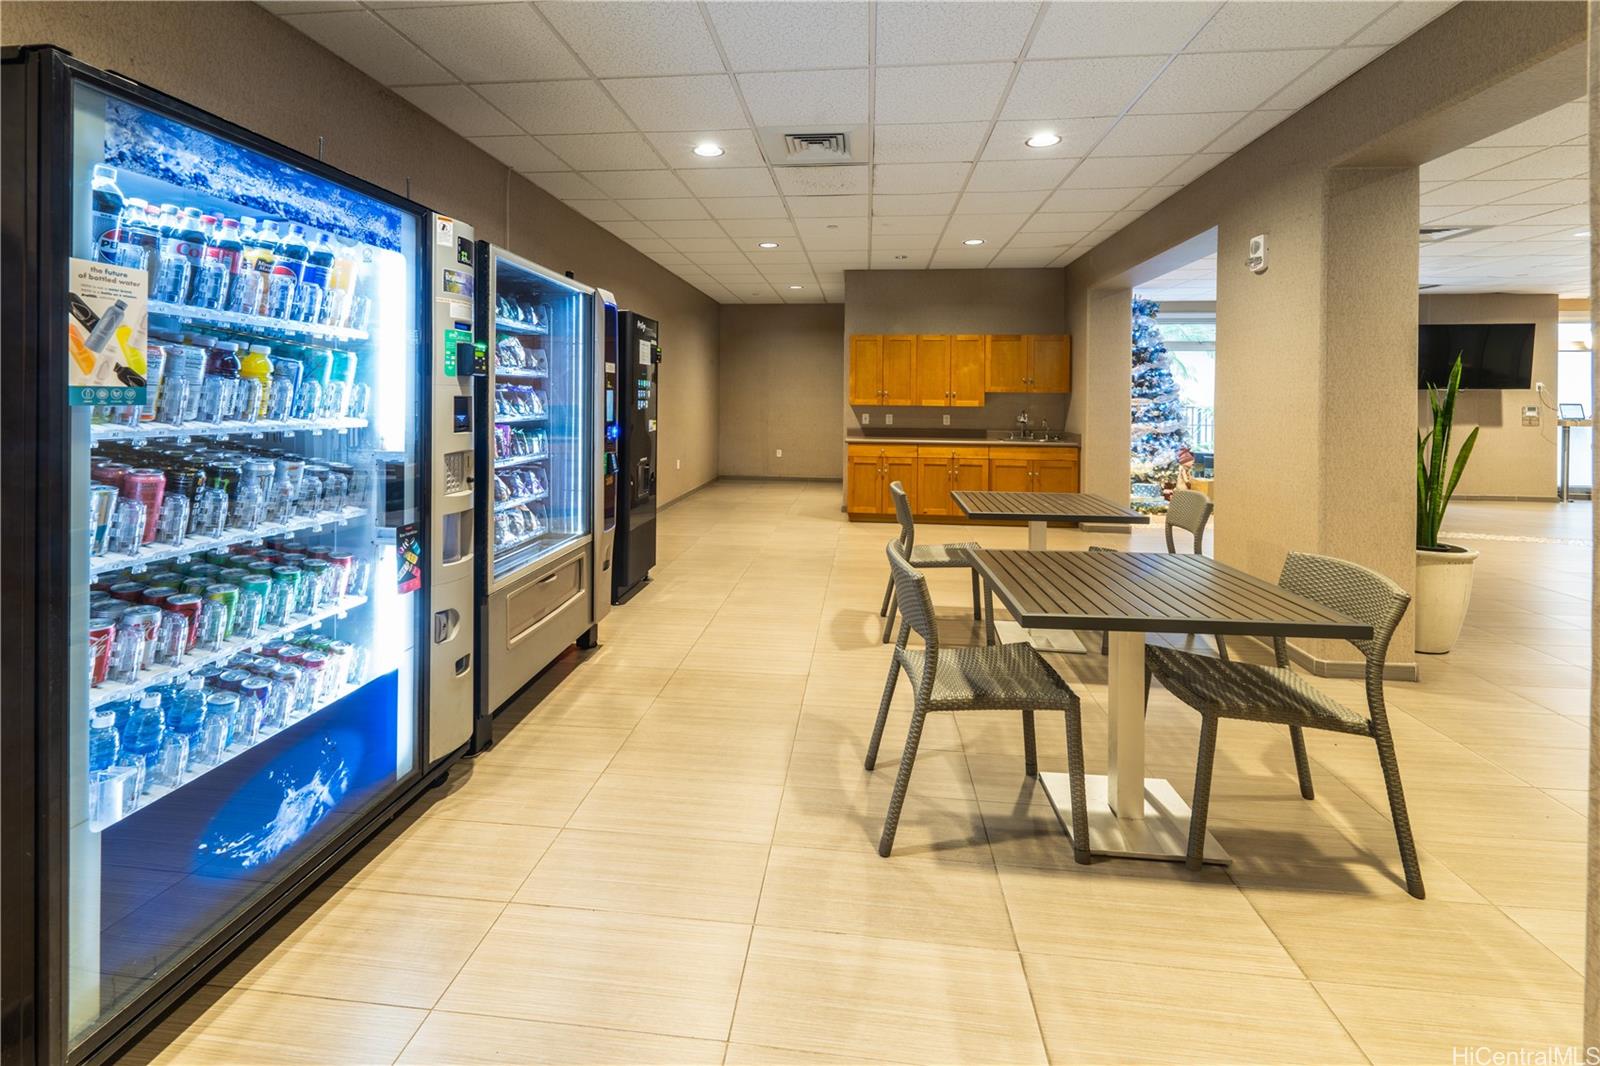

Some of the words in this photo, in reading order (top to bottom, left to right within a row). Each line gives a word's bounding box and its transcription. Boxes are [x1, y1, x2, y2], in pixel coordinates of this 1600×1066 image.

[90, 266, 103, 274] the
[104, 268, 128, 278] future
[88, 273, 117, 284] bottled
[118, 279, 140, 287] water
